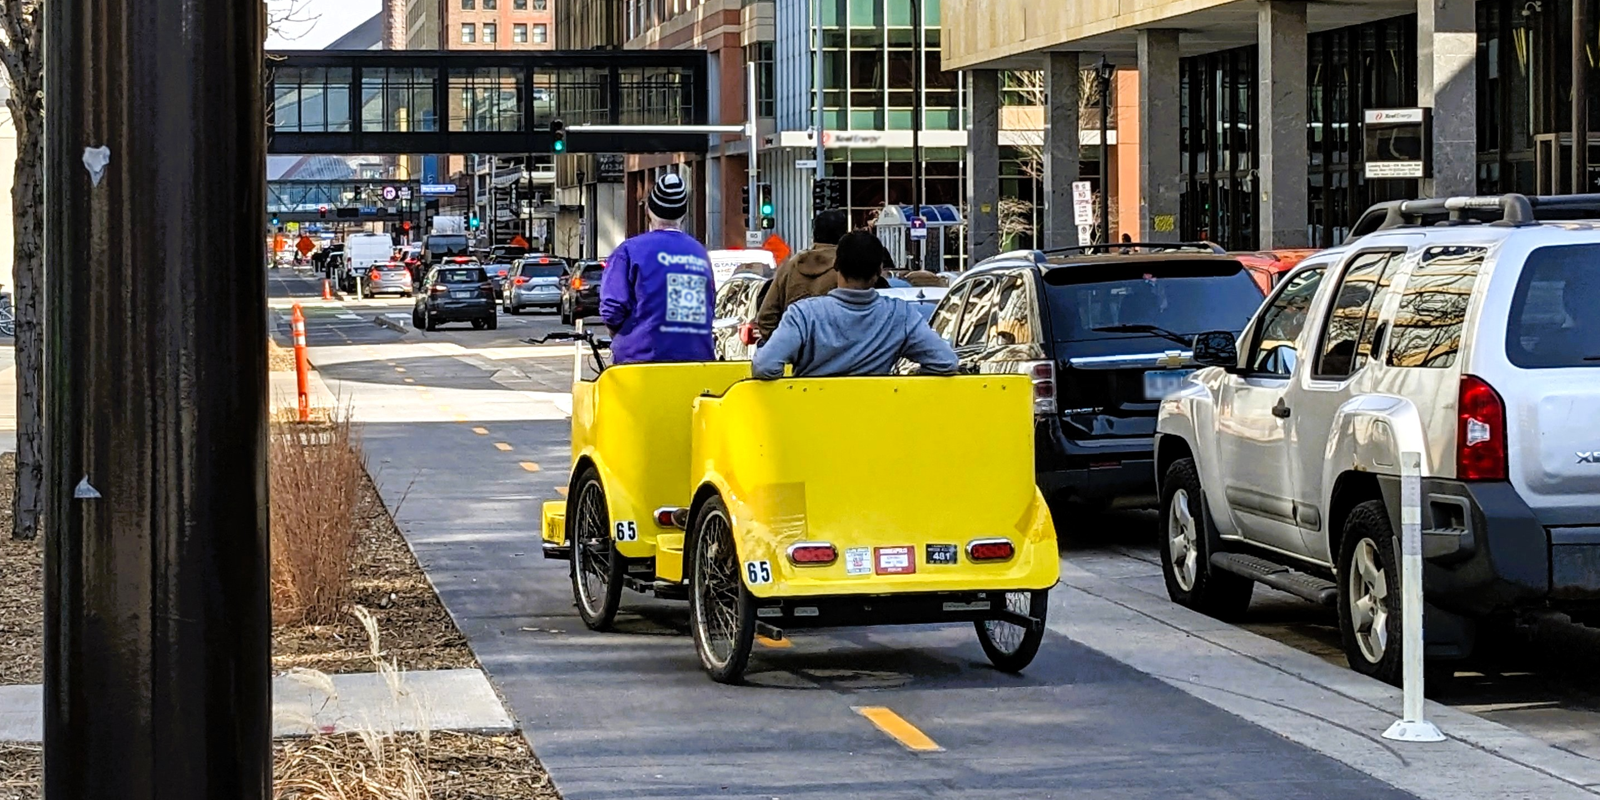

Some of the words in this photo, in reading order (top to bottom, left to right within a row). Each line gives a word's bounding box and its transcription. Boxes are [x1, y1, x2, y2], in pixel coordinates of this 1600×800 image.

[657, 252, 708, 267] Quantum
[616, 521, 636, 541] 65
[932, 551, 950, 560] 481
[747, 561, 770, 583] 65
